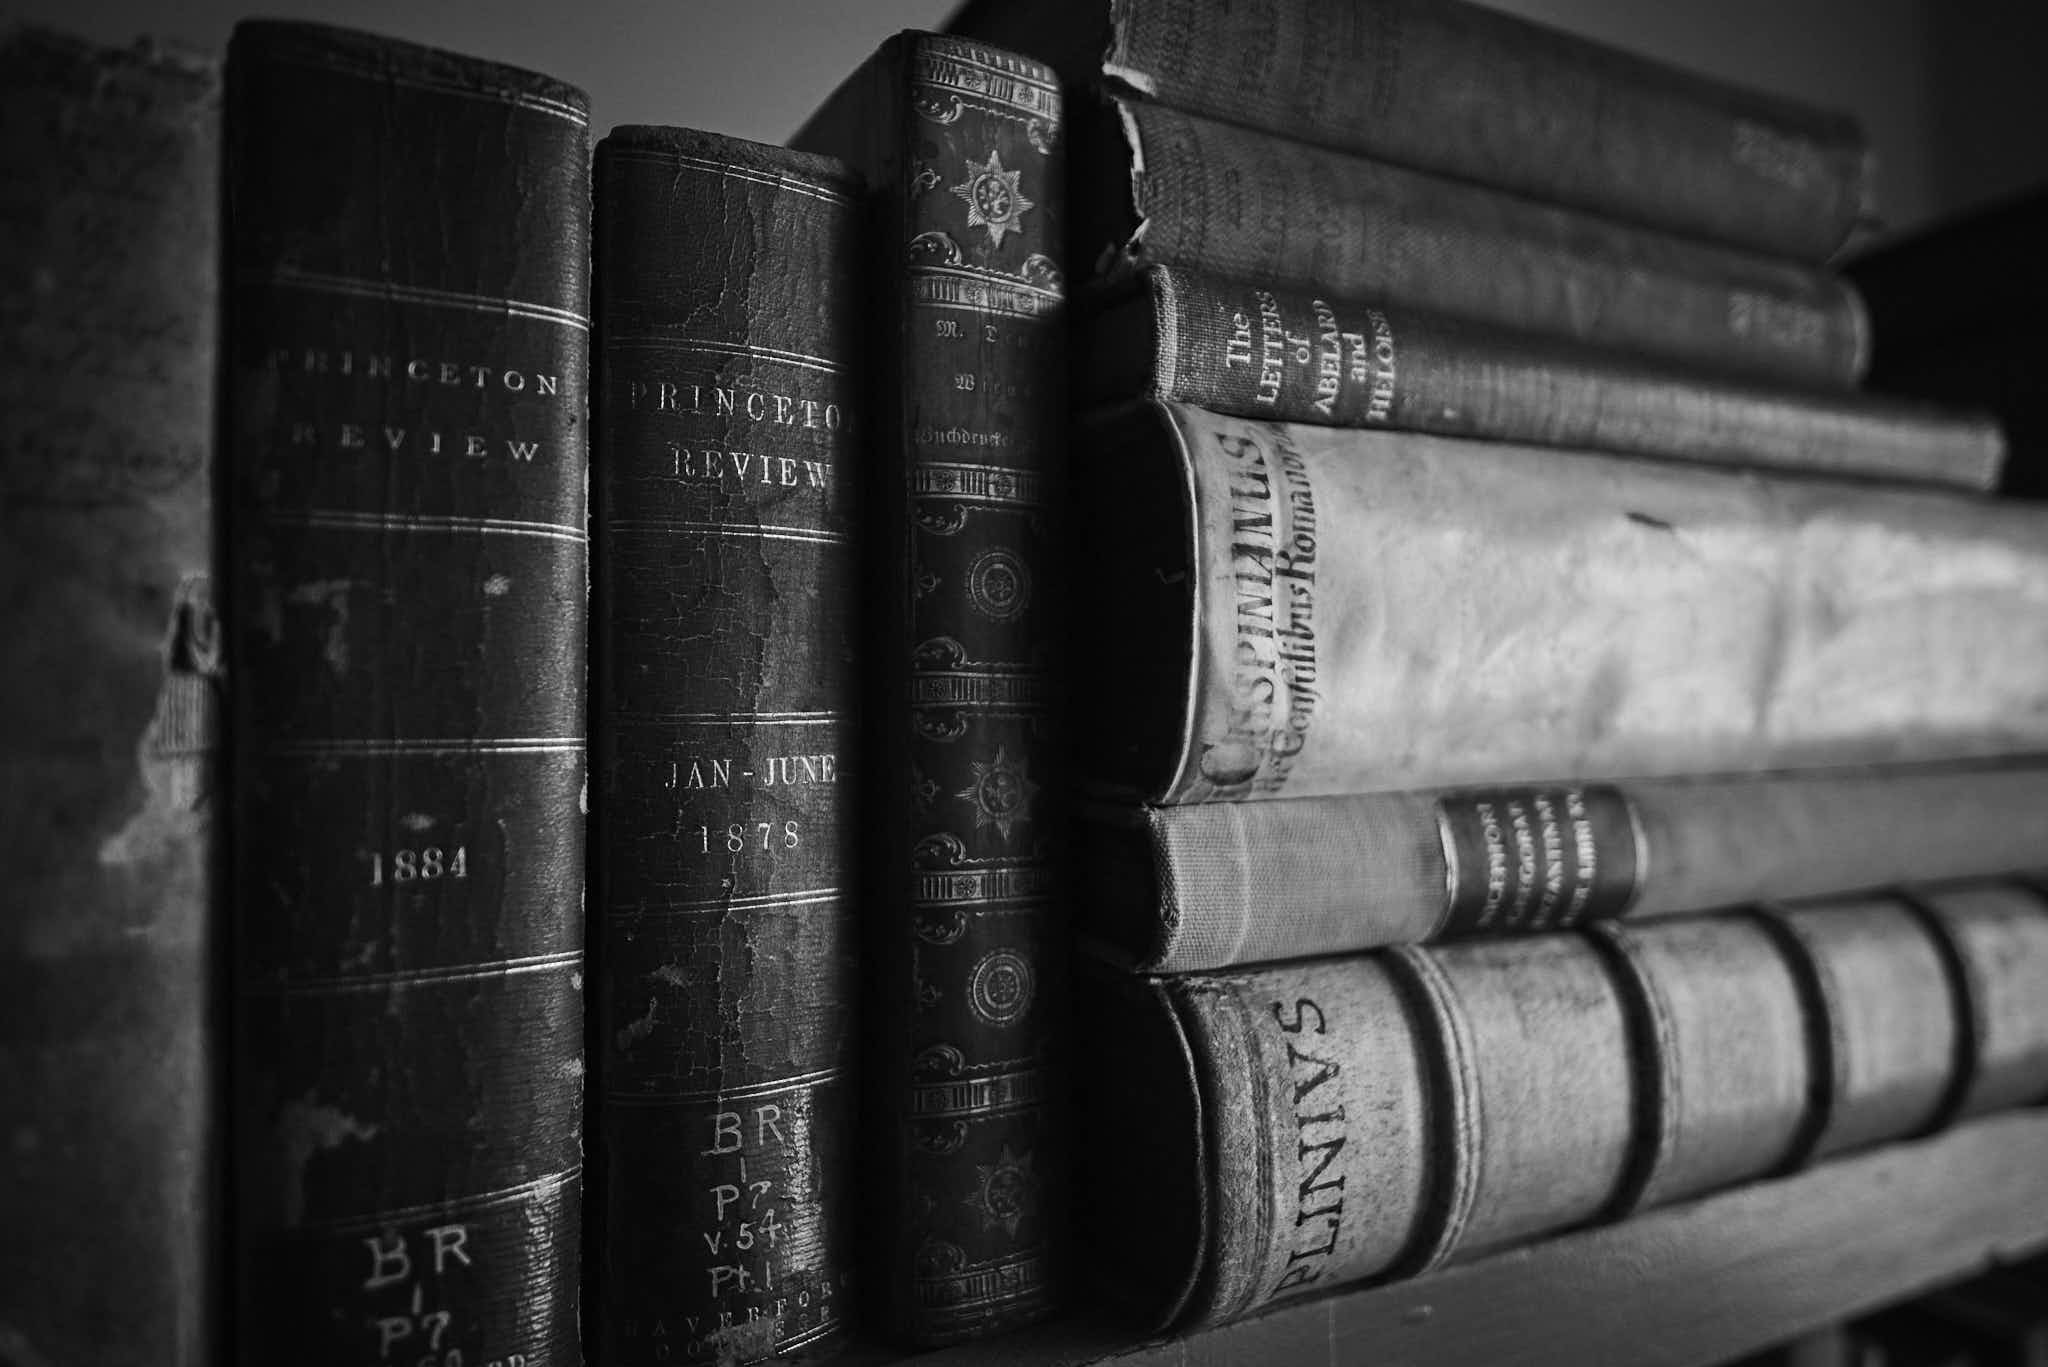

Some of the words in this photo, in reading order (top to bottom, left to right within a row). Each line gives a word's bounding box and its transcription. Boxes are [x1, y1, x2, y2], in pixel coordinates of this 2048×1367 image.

[1226, 312, 1251, 368] The
[1256, 291, 1284, 406] LETTERS
[1286, 330, 1311, 364] of
[1312, 299, 1342, 416] ABELARD
[1342, 332, 1370, 385] and
[631, 382, 852, 433] PRINCETO
[672, 447, 833, 489] REVIEW
[701, 820, 799, 854] 1878
[369, 846, 468, 888] 1884
